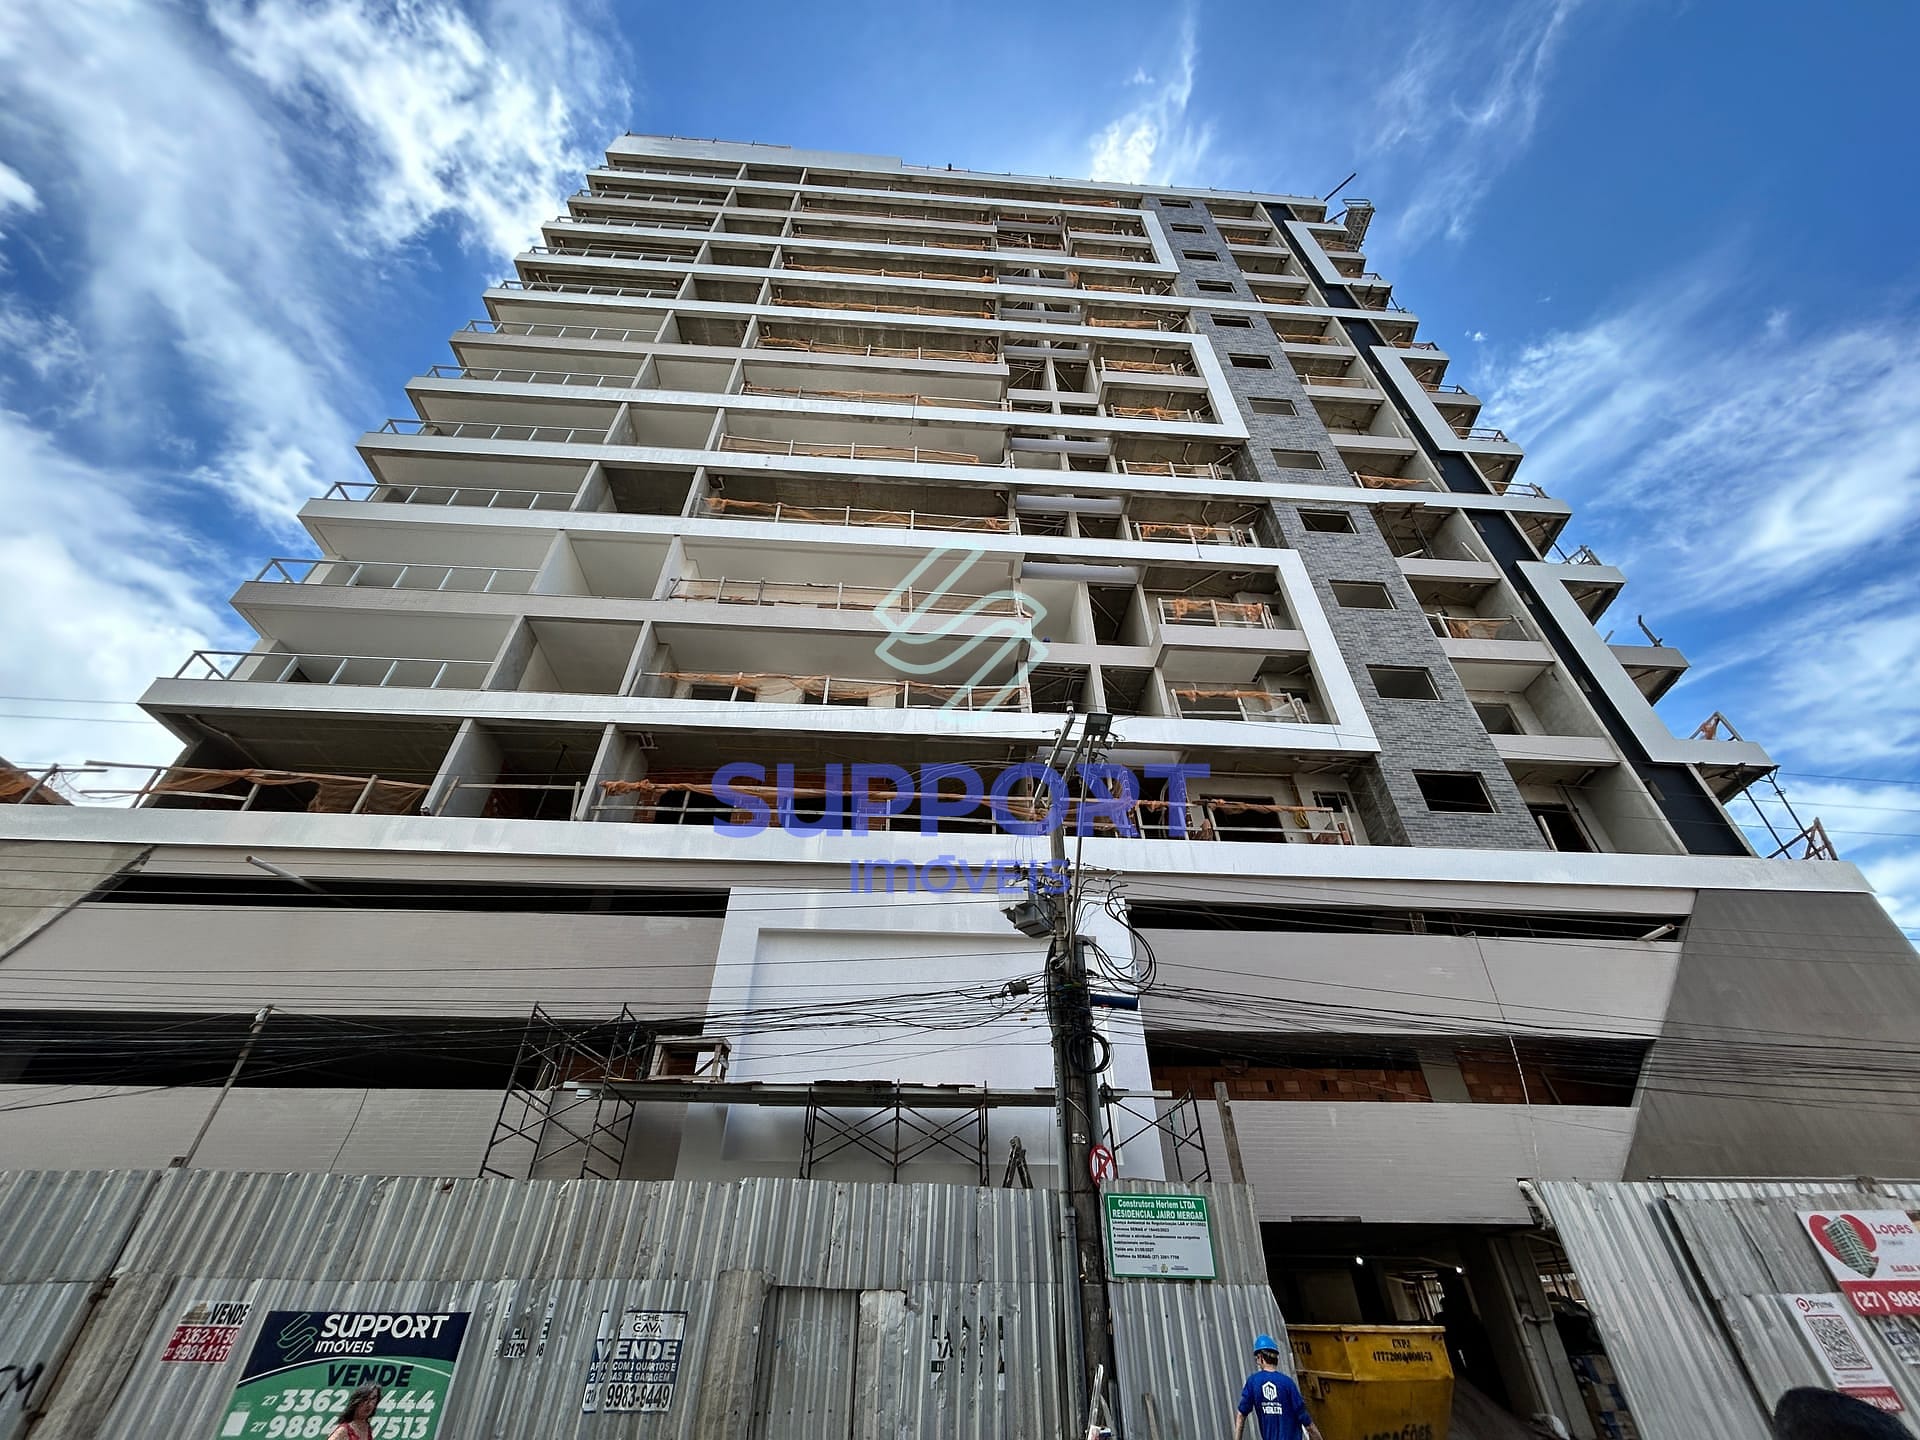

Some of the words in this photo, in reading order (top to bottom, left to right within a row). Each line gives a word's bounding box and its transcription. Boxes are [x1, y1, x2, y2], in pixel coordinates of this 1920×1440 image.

[1112, 1209, 1155, 1219] RESIDENCIAL
[1156, 1211, 1175, 1219] JAIRO
[1870, 1223, 1914, 1237] Lopes
[1852, 1291, 1891, 1312] (27)
[210, 1303, 250, 1325] VENDE
[320, 1314, 450, 1339] SUPPORT
[596, 1340, 679, 1361] VENDE
[327, 1364, 414, 1388] VENDE
